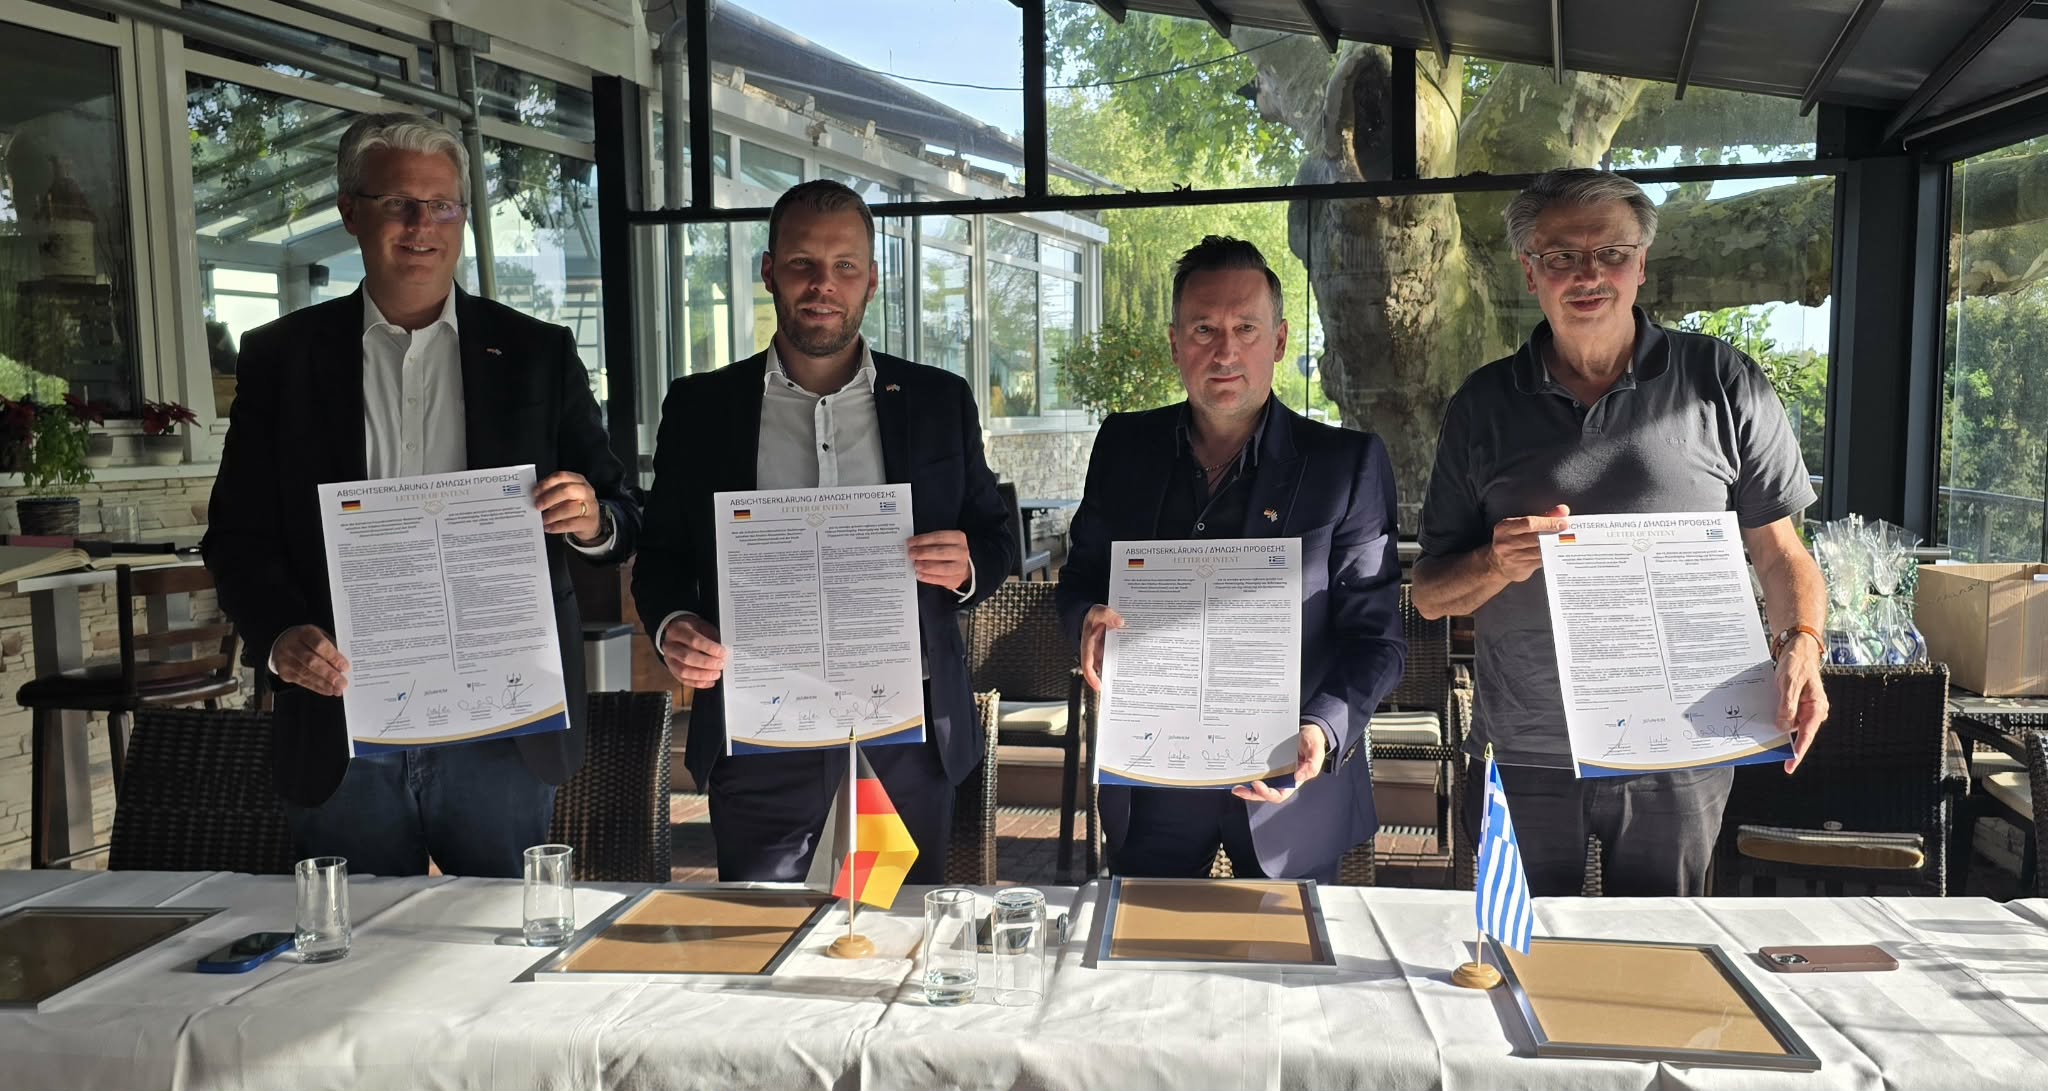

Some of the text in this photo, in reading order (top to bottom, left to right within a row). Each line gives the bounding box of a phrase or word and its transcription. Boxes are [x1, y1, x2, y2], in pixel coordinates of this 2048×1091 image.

[395, 492, 428, 502] LETTER
[440, 488, 470, 498] INTENT
[781, 504, 810, 513] LETTER
[821, 503, 849, 512] INTENT
[1606, 530, 1635, 538] LETTER
[1647, 529, 1676, 537] INTENT
[1173, 556, 1200, 564] LETTER
